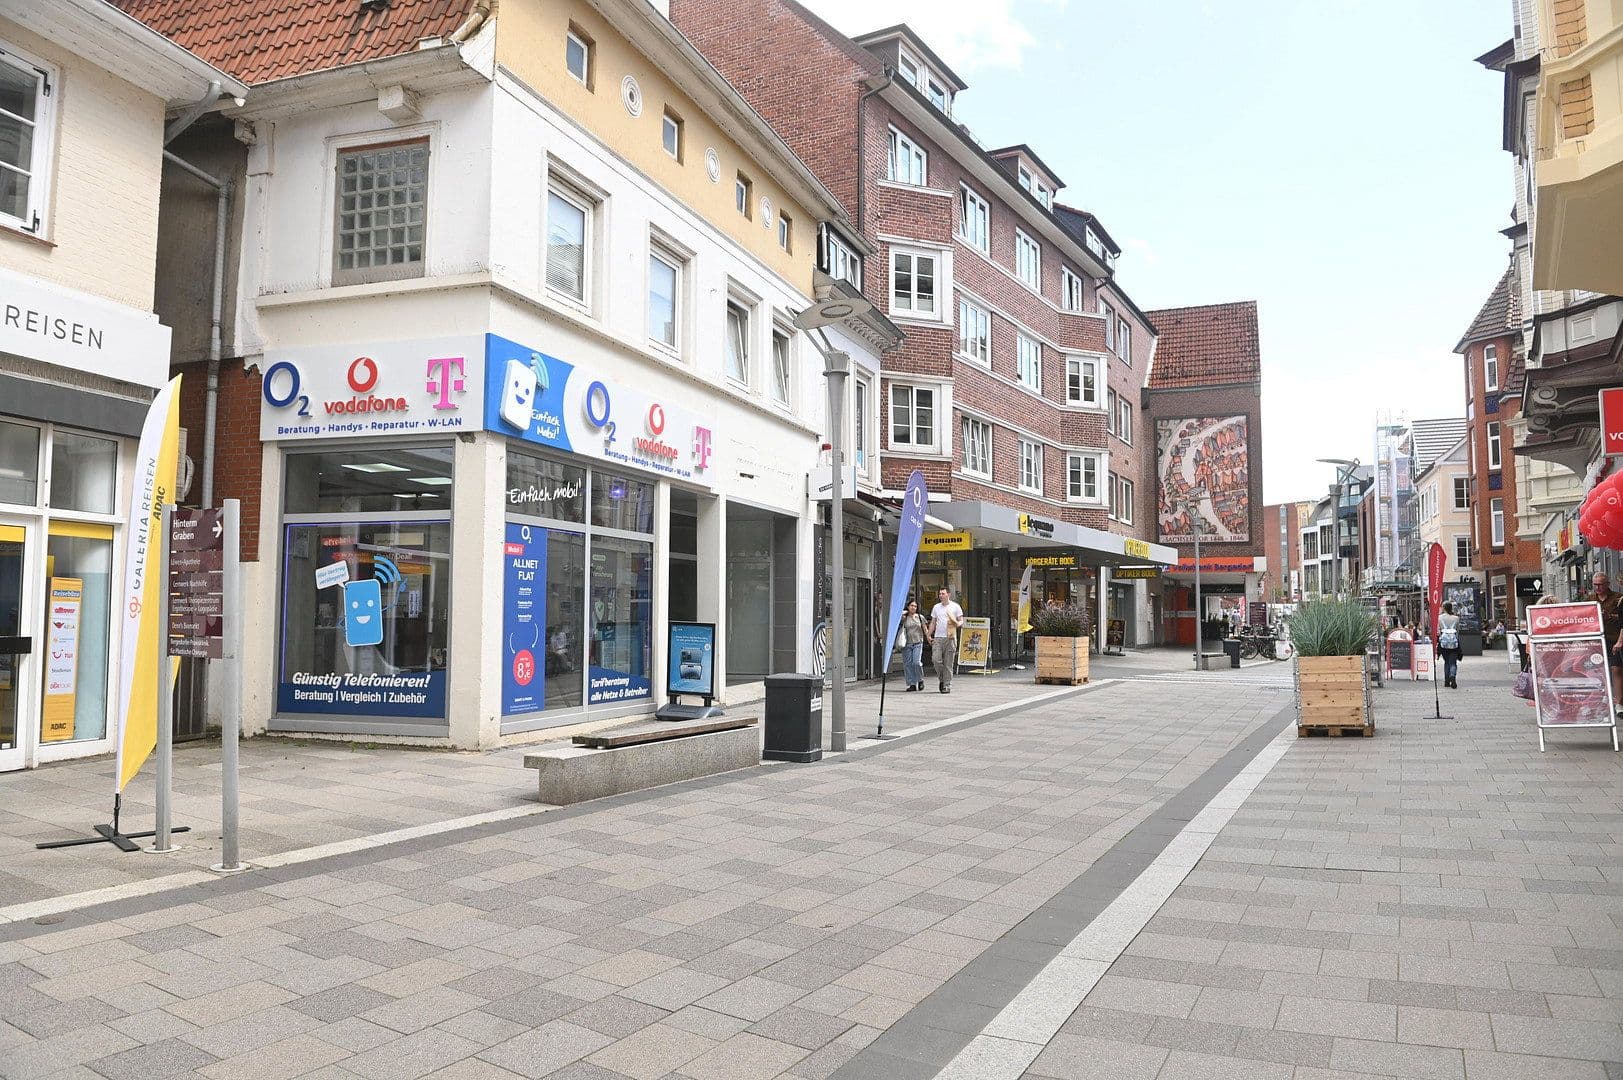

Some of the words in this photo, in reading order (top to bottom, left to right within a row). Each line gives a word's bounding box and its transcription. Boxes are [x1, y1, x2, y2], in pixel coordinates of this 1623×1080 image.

[5, 304, 103, 350] REISEN
[324, 394, 407, 415] vodafone
[532, 409, 560, 427] Einfach
[278, 425, 320, 435] Beratung
[328, 423, 363, 433] Handys
[371, 420, 419, 431] Reparatur
[427, 417, 462, 427] W-LAN
[604, 448, 628, 463] Beratung
[636, 437, 679, 459] vodafone
[506, 485, 552, 503] Einfach
[152, 486, 166, 521] ADAC
[133, 516, 150, 590] GALERIA
[142, 458, 156, 512] REISEN
[173, 519, 198, 528] Hinterm
[172, 531, 195, 540] Graben
[924, 537, 963, 545] leguano
[513, 559, 539, 570] ALLNET
[1059, 557, 1075, 565] BODE
[518, 571, 535, 581] FLAT
[1552, 616, 1595, 625] vodafone
[292, 672, 341, 690] Günstig
[344, 673, 432, 688] Telefonieren!
[591, 677, 630, 688] Tarifberatung
[294, 690, 333, 704] Beratung
[340, 691, 381, 705] Vergleich
[388, 692, 427, 704] Zubehör
[591, 691, 602, 701] alle
